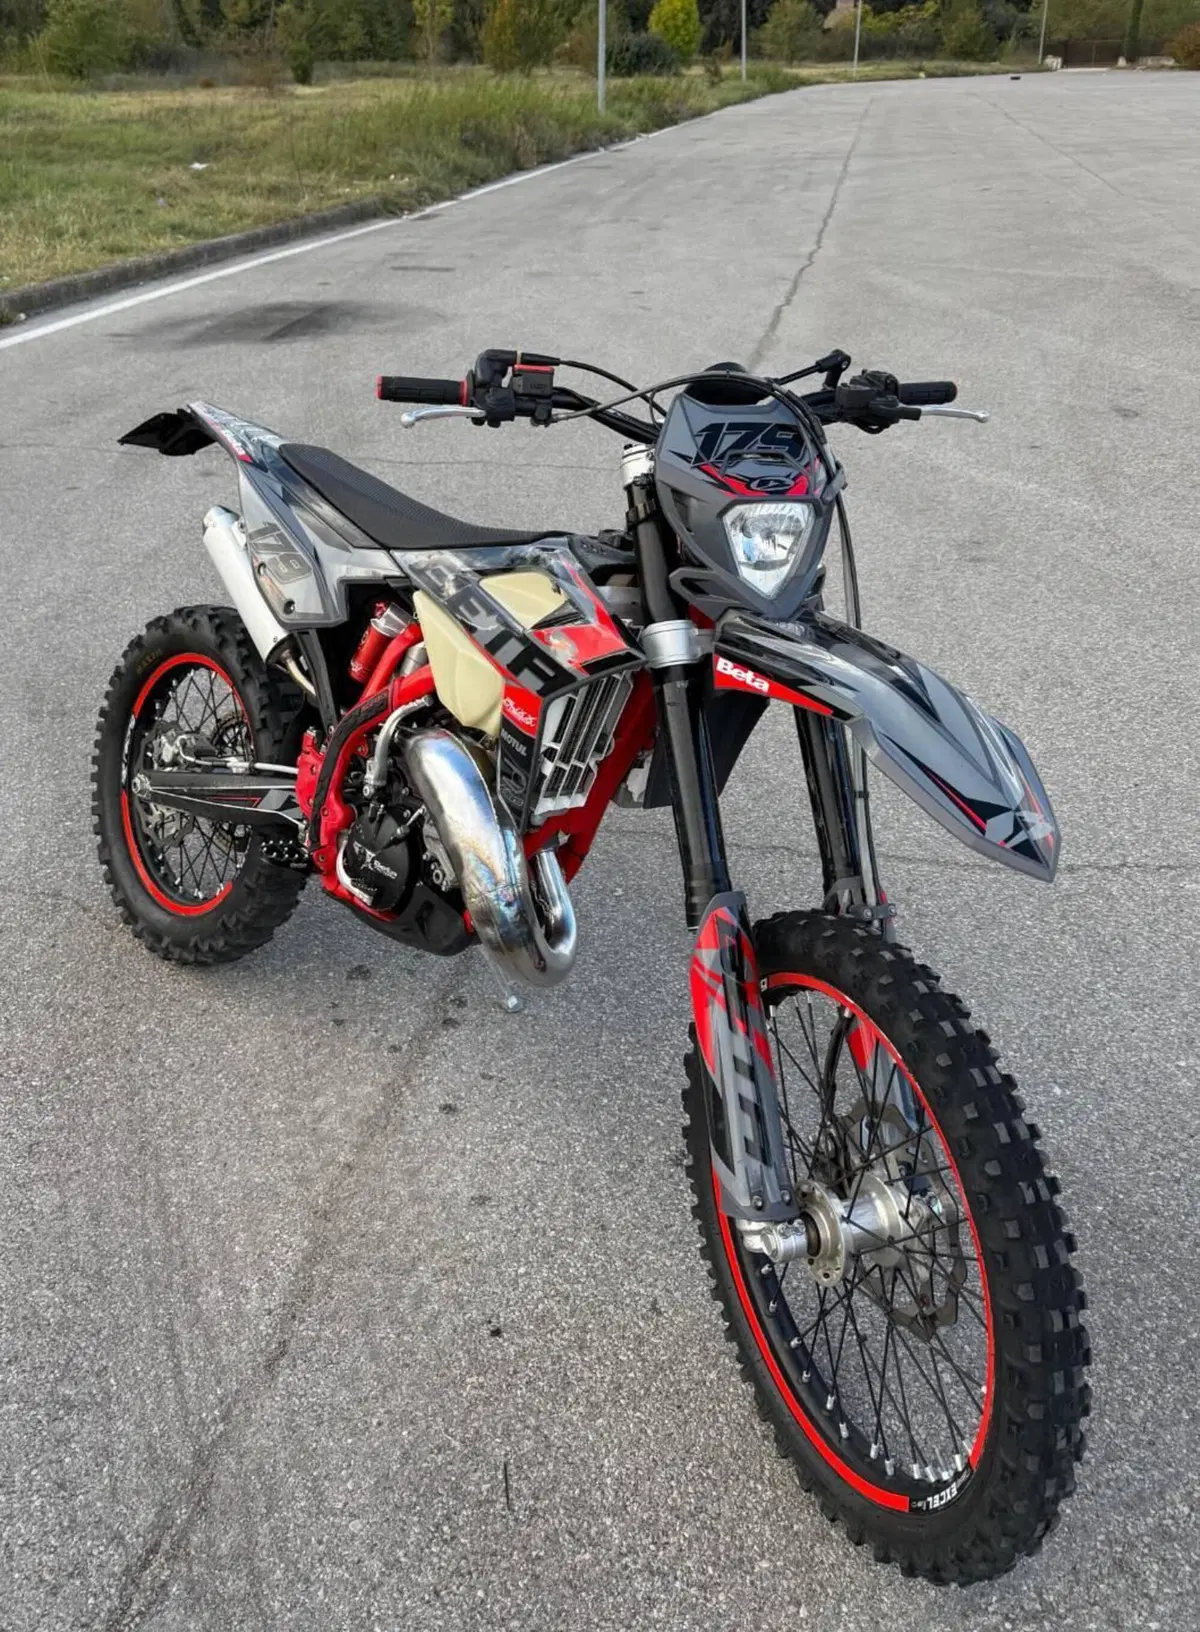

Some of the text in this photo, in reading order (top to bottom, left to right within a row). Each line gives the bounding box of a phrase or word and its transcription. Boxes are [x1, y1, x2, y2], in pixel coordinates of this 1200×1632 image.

[716, 656, 770, 693] Beta
[500, 728, 527, 757] MOTUL
[926, 1482, 958, 1510] EXCEL
